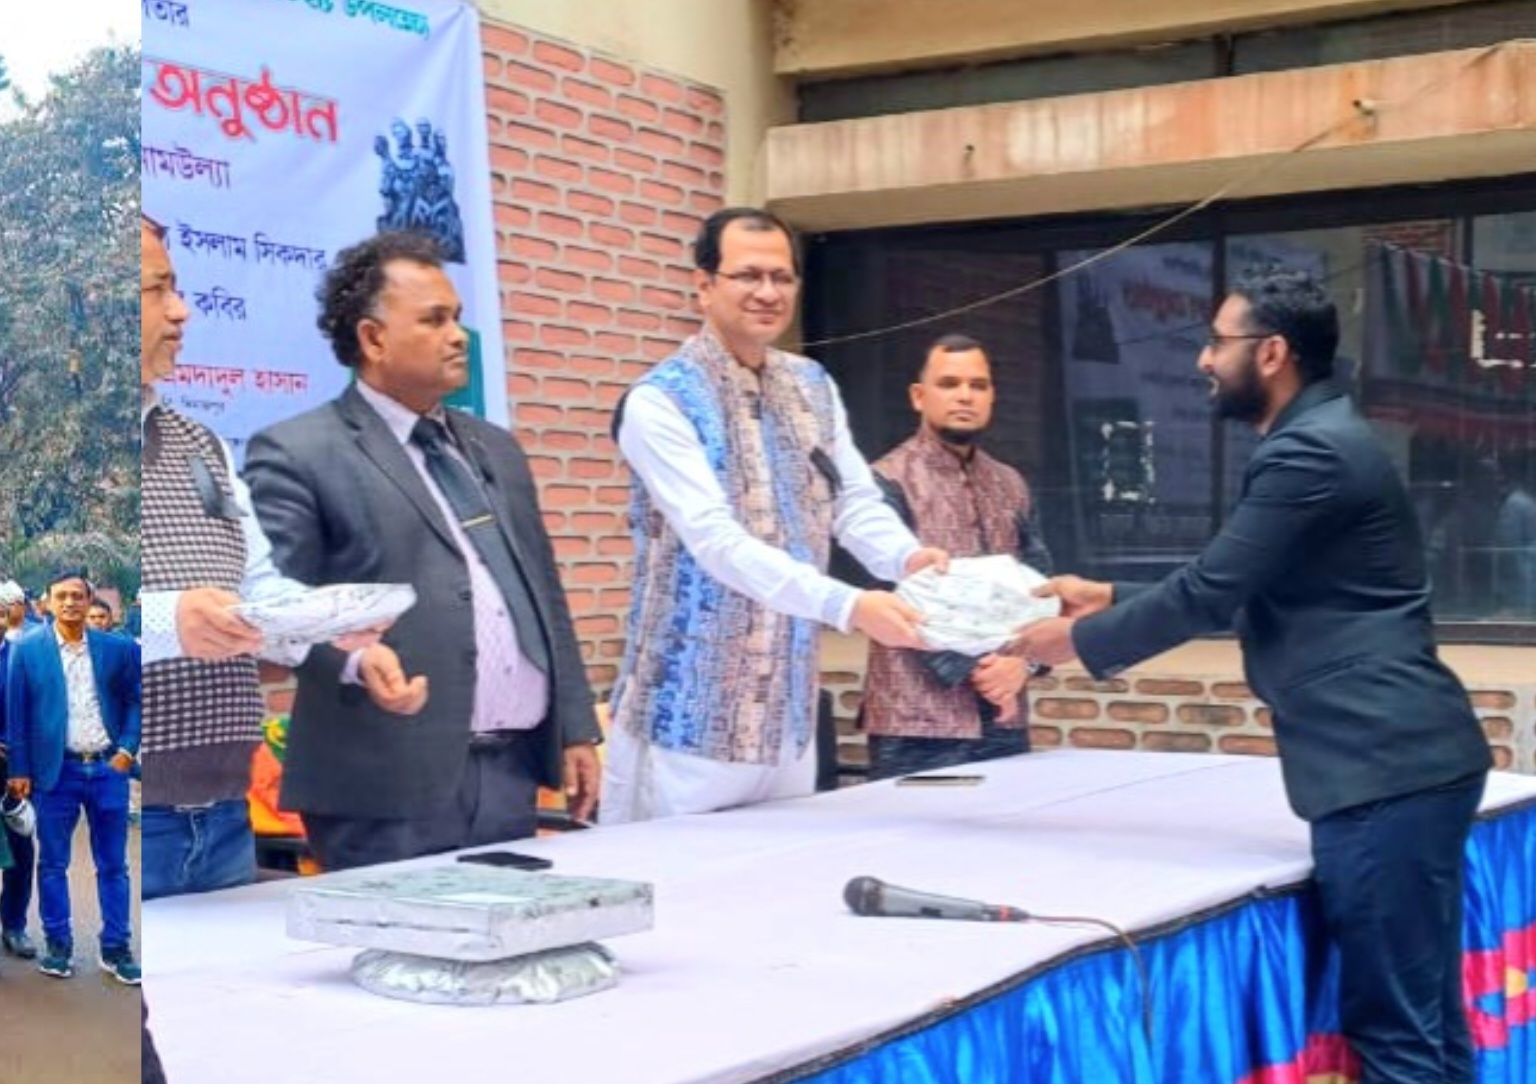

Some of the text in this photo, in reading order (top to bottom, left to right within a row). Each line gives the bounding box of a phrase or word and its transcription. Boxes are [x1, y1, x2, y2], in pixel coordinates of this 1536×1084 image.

[148, 59, 340, 143] অনুষ্ঠান
[176, 219, 247, 261] ইসলাম
[192, 285, 247, 319] কবির
[254, 369, 309, 395] হাসান
